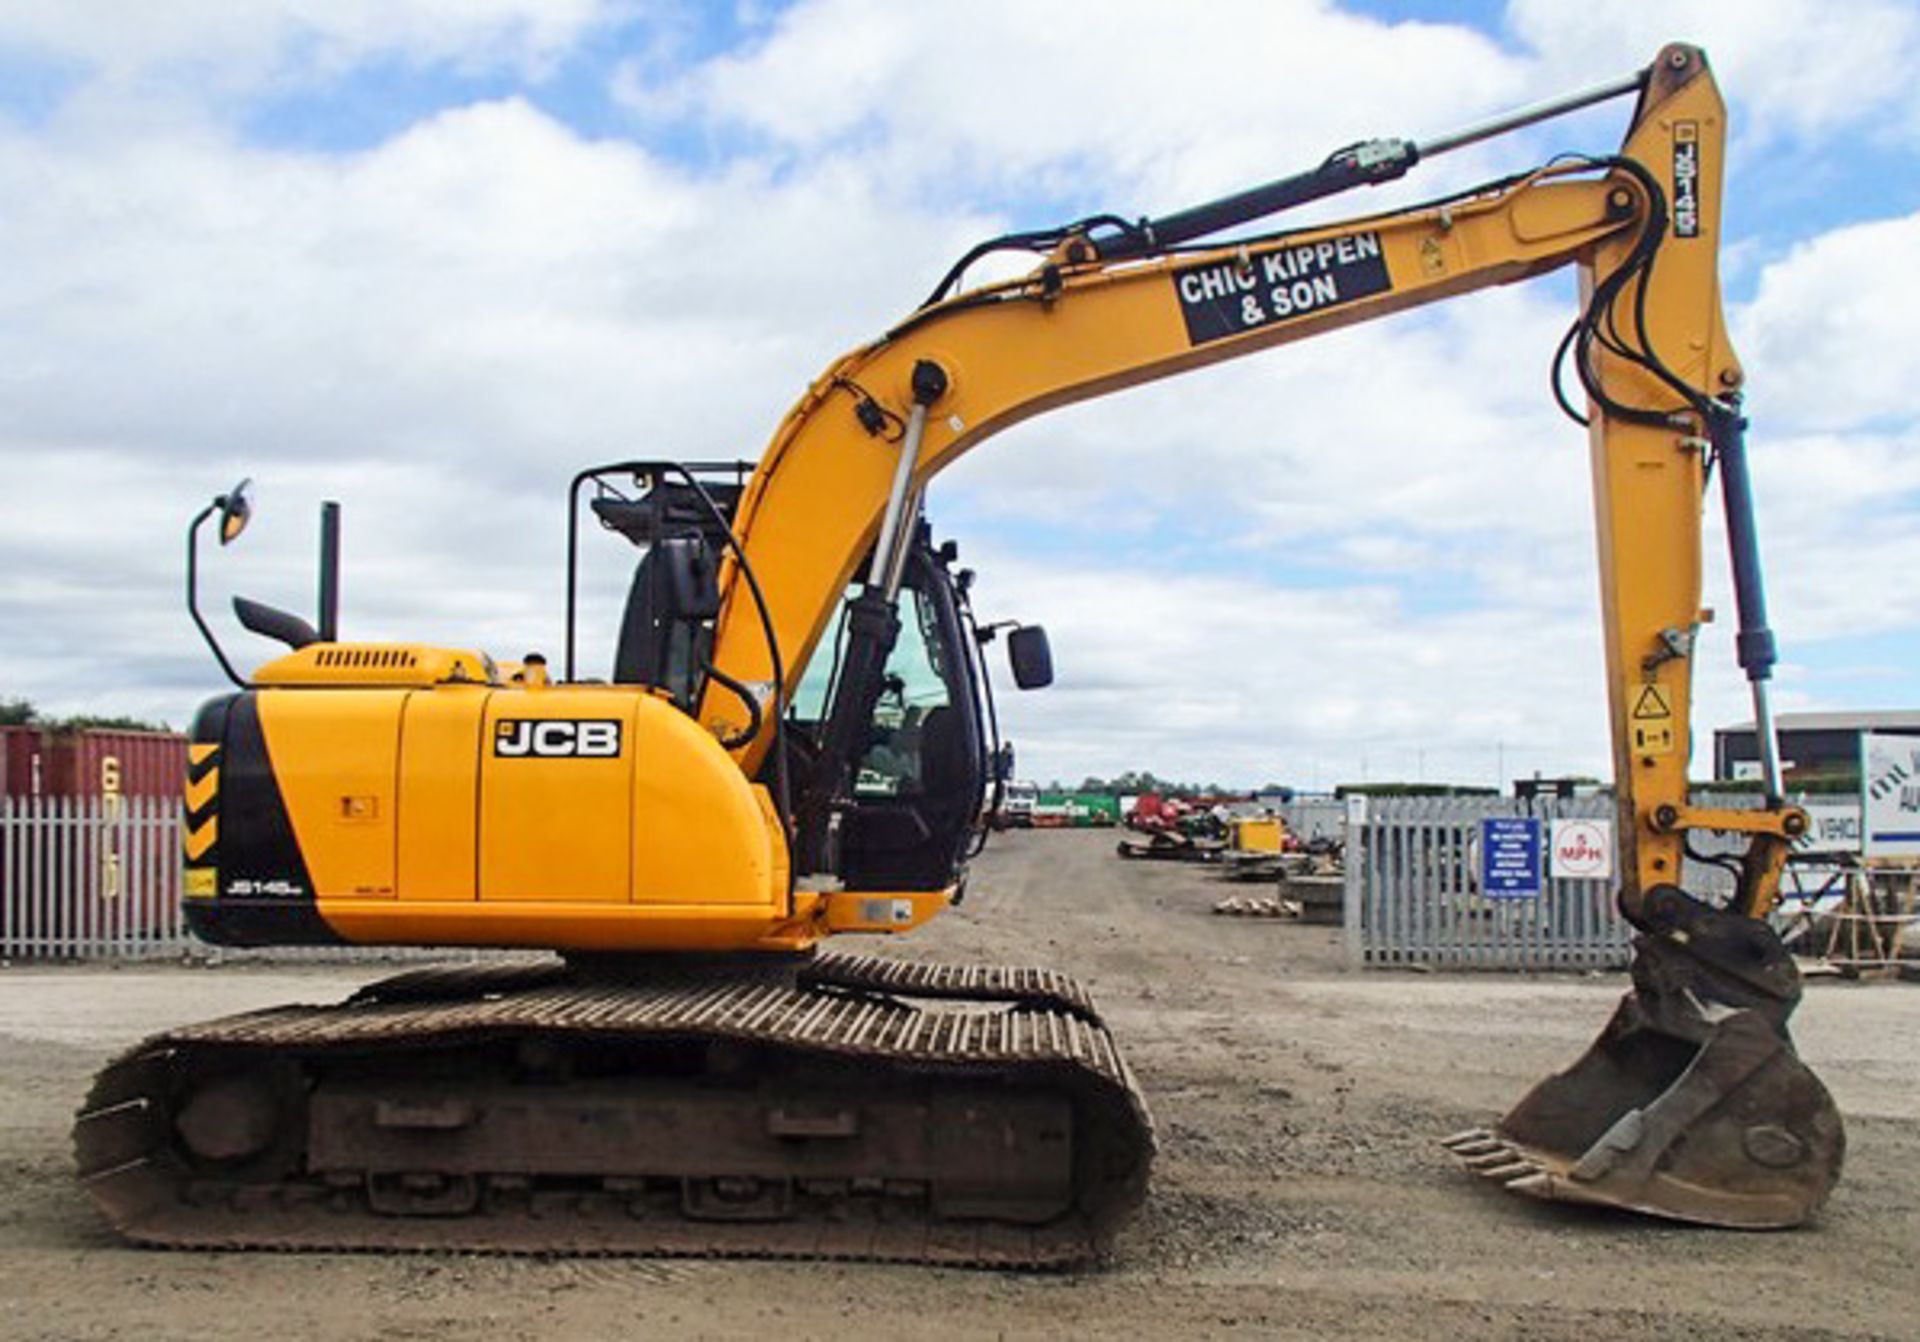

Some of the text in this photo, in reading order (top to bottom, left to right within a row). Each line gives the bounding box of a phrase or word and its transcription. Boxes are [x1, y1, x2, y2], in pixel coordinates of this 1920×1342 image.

[1180, 232, 1379, 303] CHIC KIPPEN
[1241, 275, 1339, 325] & SON
[496, 721, 619, 756] JCB
[1557, 846, 1603, 861] MPH
